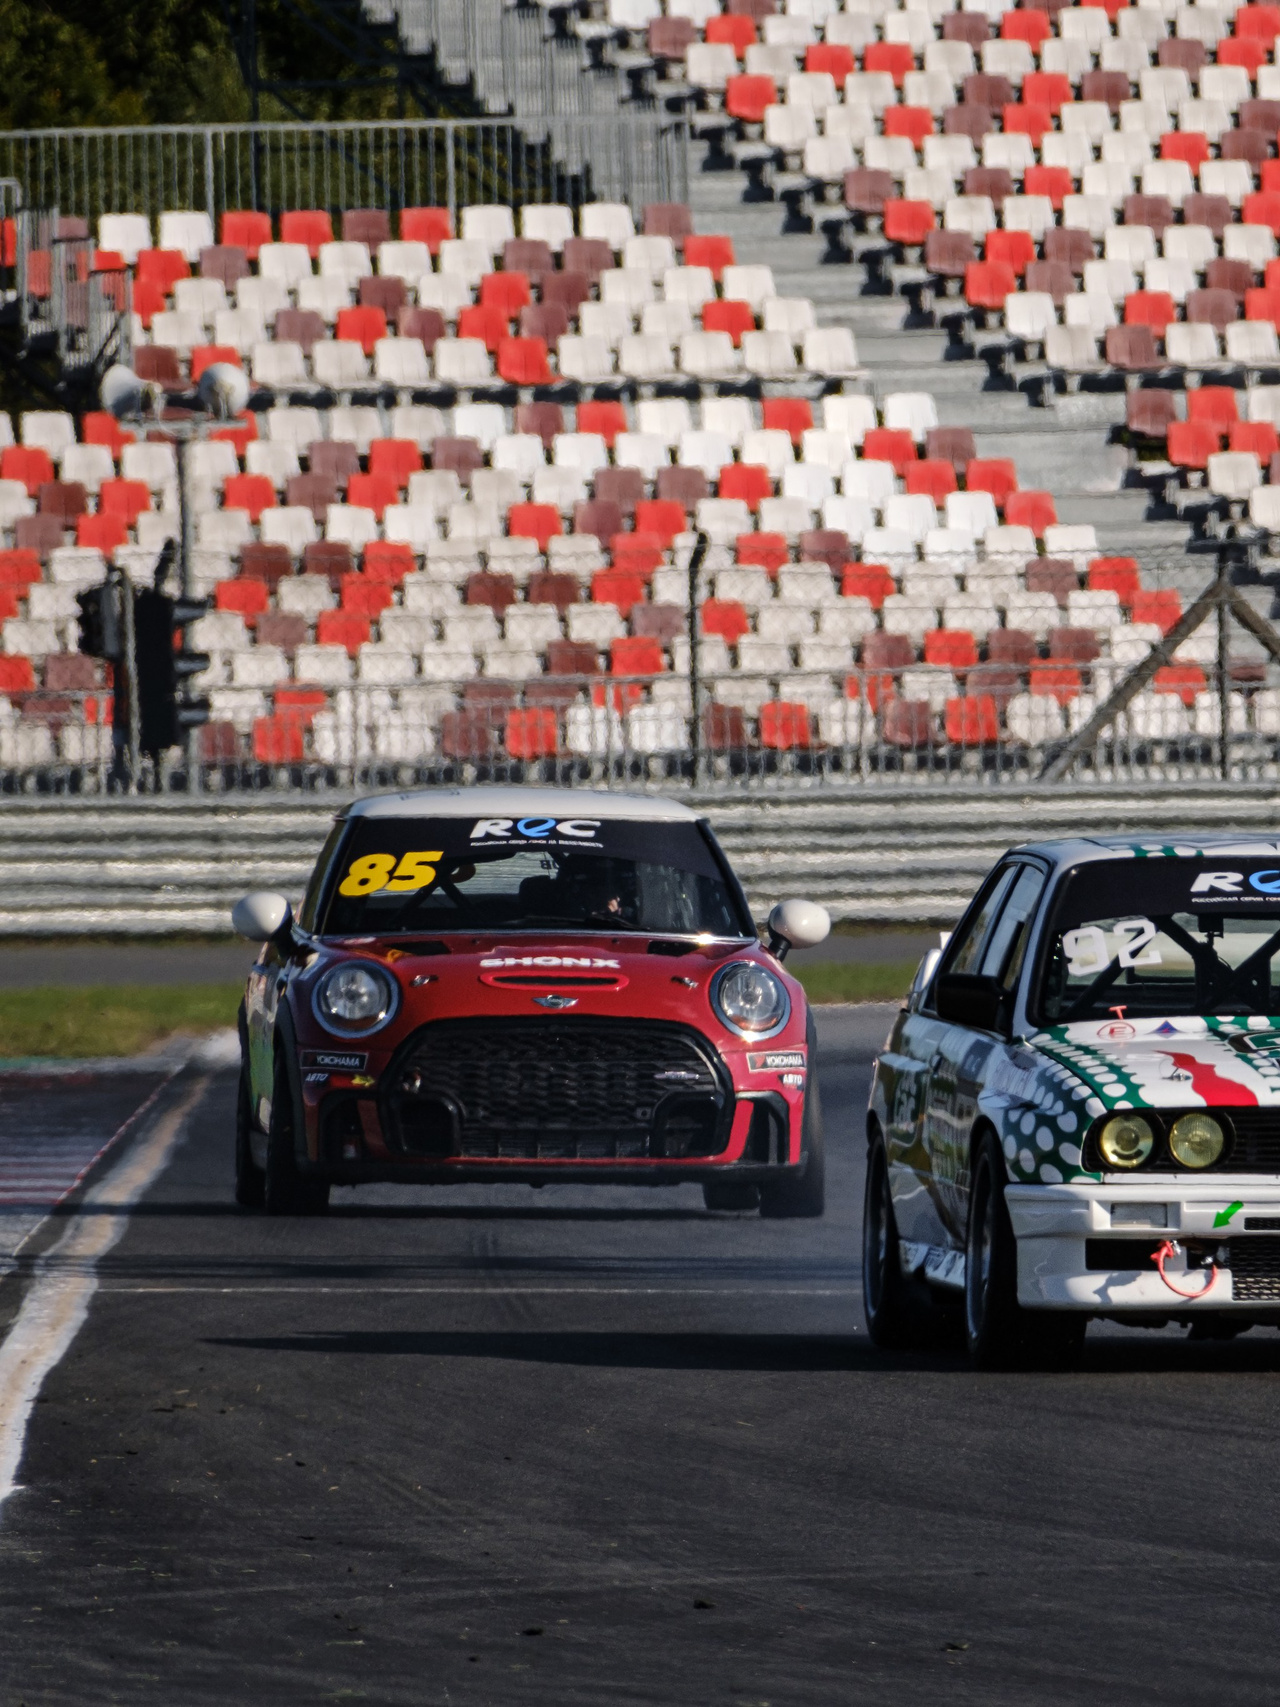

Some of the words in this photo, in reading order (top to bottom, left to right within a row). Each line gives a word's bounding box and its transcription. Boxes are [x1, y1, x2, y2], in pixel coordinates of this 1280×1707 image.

[339, 850, 444, 897] 85
[1062, 918, 1163, 978] 92
[479, 956, 621, 969] SHONX
[316, 1055, 360, 1067] YOKOHAMA
[765, 1055, 803, 1067] YOKOHAMA
